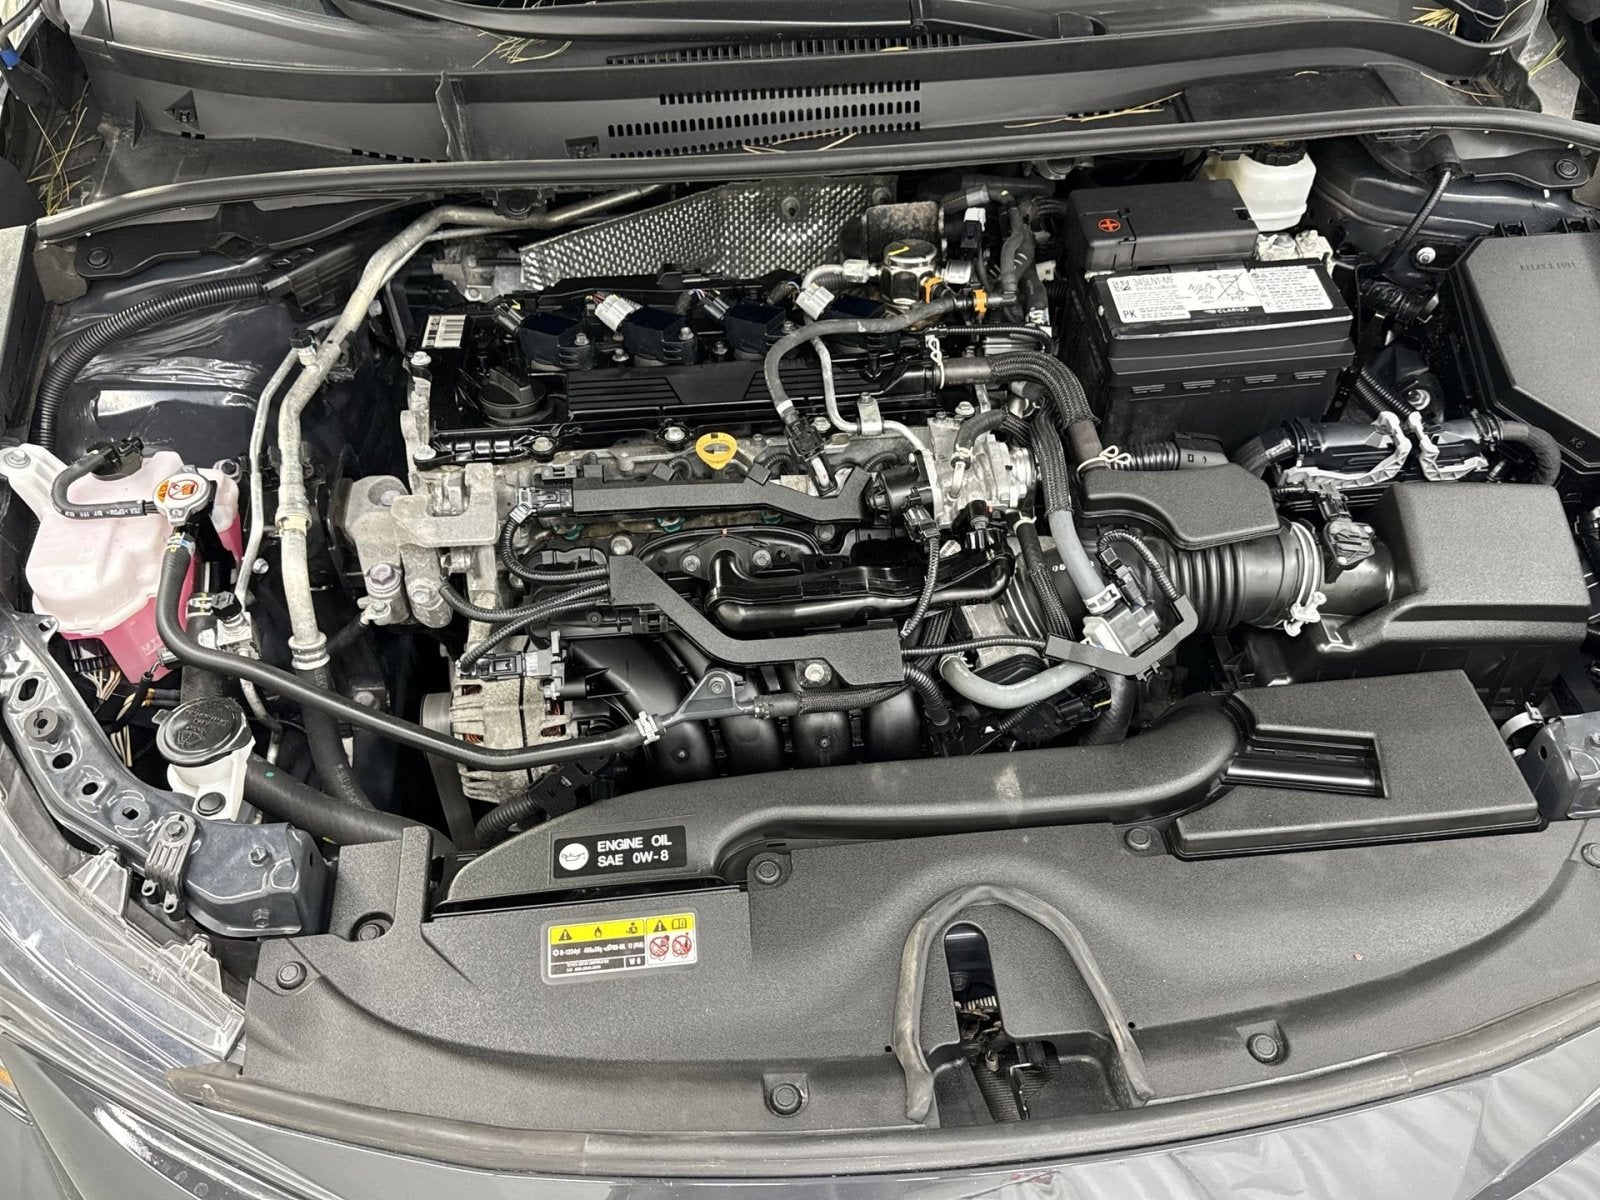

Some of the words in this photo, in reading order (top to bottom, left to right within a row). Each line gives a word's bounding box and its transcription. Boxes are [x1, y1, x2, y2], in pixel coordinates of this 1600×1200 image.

[1123, 309, 1137, 319] PK
[1217, 306, 1250, 314] CLARIOS
[597, 836, 644, 853] ENGINE
[651, 834, 672, 847] OIL
[597, 853, 624, 868] SAE
[632, 849, 669, 864] 0W-8
